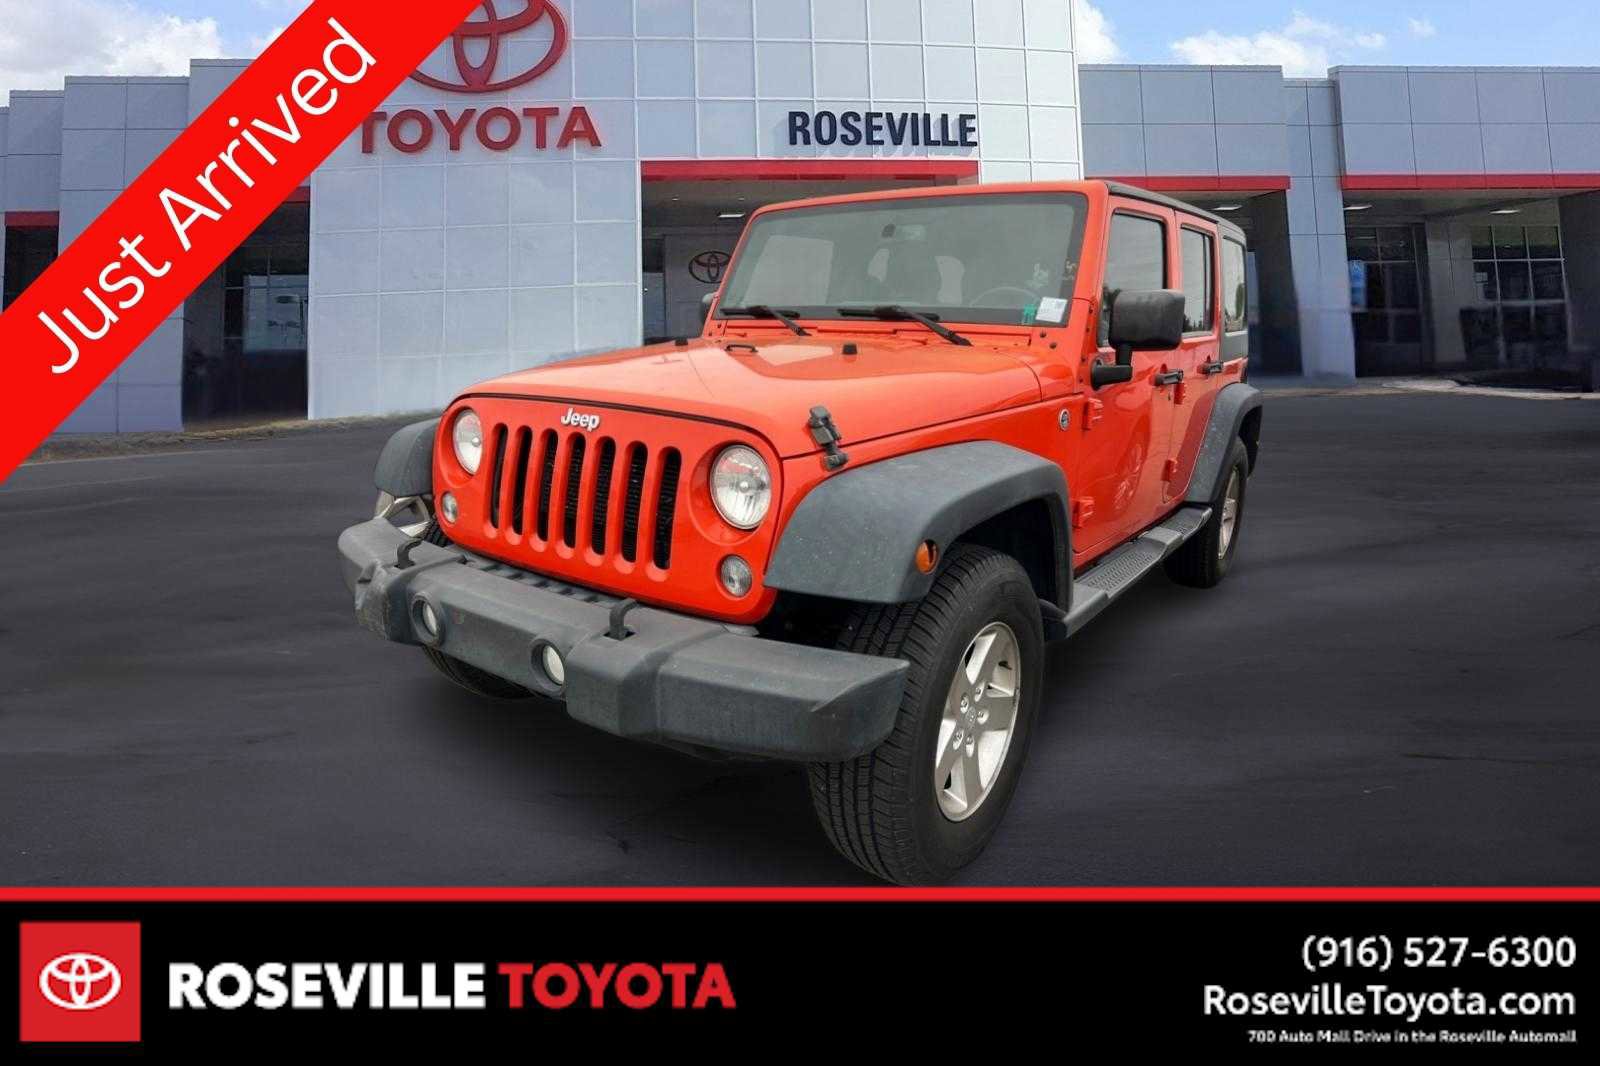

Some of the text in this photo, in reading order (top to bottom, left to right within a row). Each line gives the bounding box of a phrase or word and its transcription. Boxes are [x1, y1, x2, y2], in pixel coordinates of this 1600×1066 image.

[361, 106, 603, 154] TOYOTA
[788, 110, 978, 147] ROSEVILLE
[560, 407, 600, 432] Jeep
